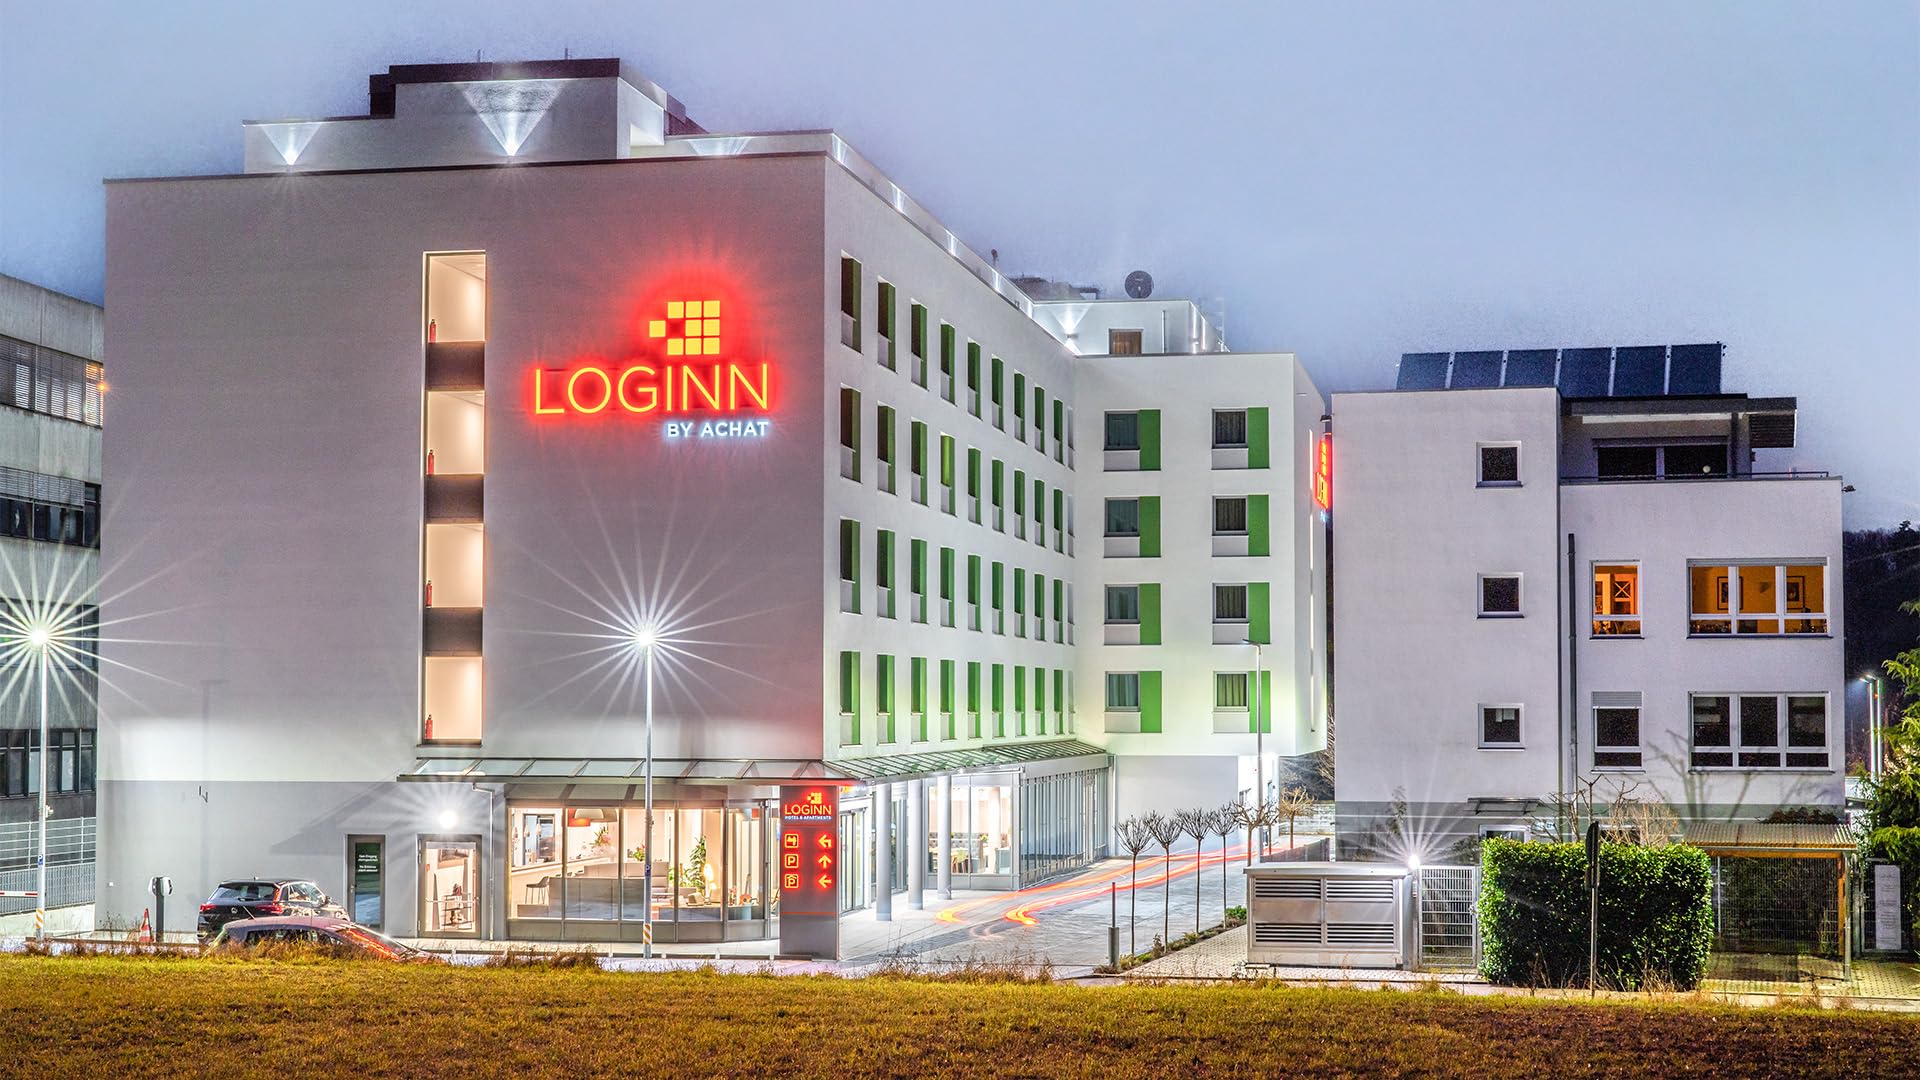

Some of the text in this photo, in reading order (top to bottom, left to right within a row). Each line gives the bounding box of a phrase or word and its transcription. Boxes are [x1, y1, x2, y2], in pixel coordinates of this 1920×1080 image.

[535, 363, 768, 414] LOGINN
[667, 421, 769, 437] BY ACHAT
[784, 804, 832, 815] LOGINN
